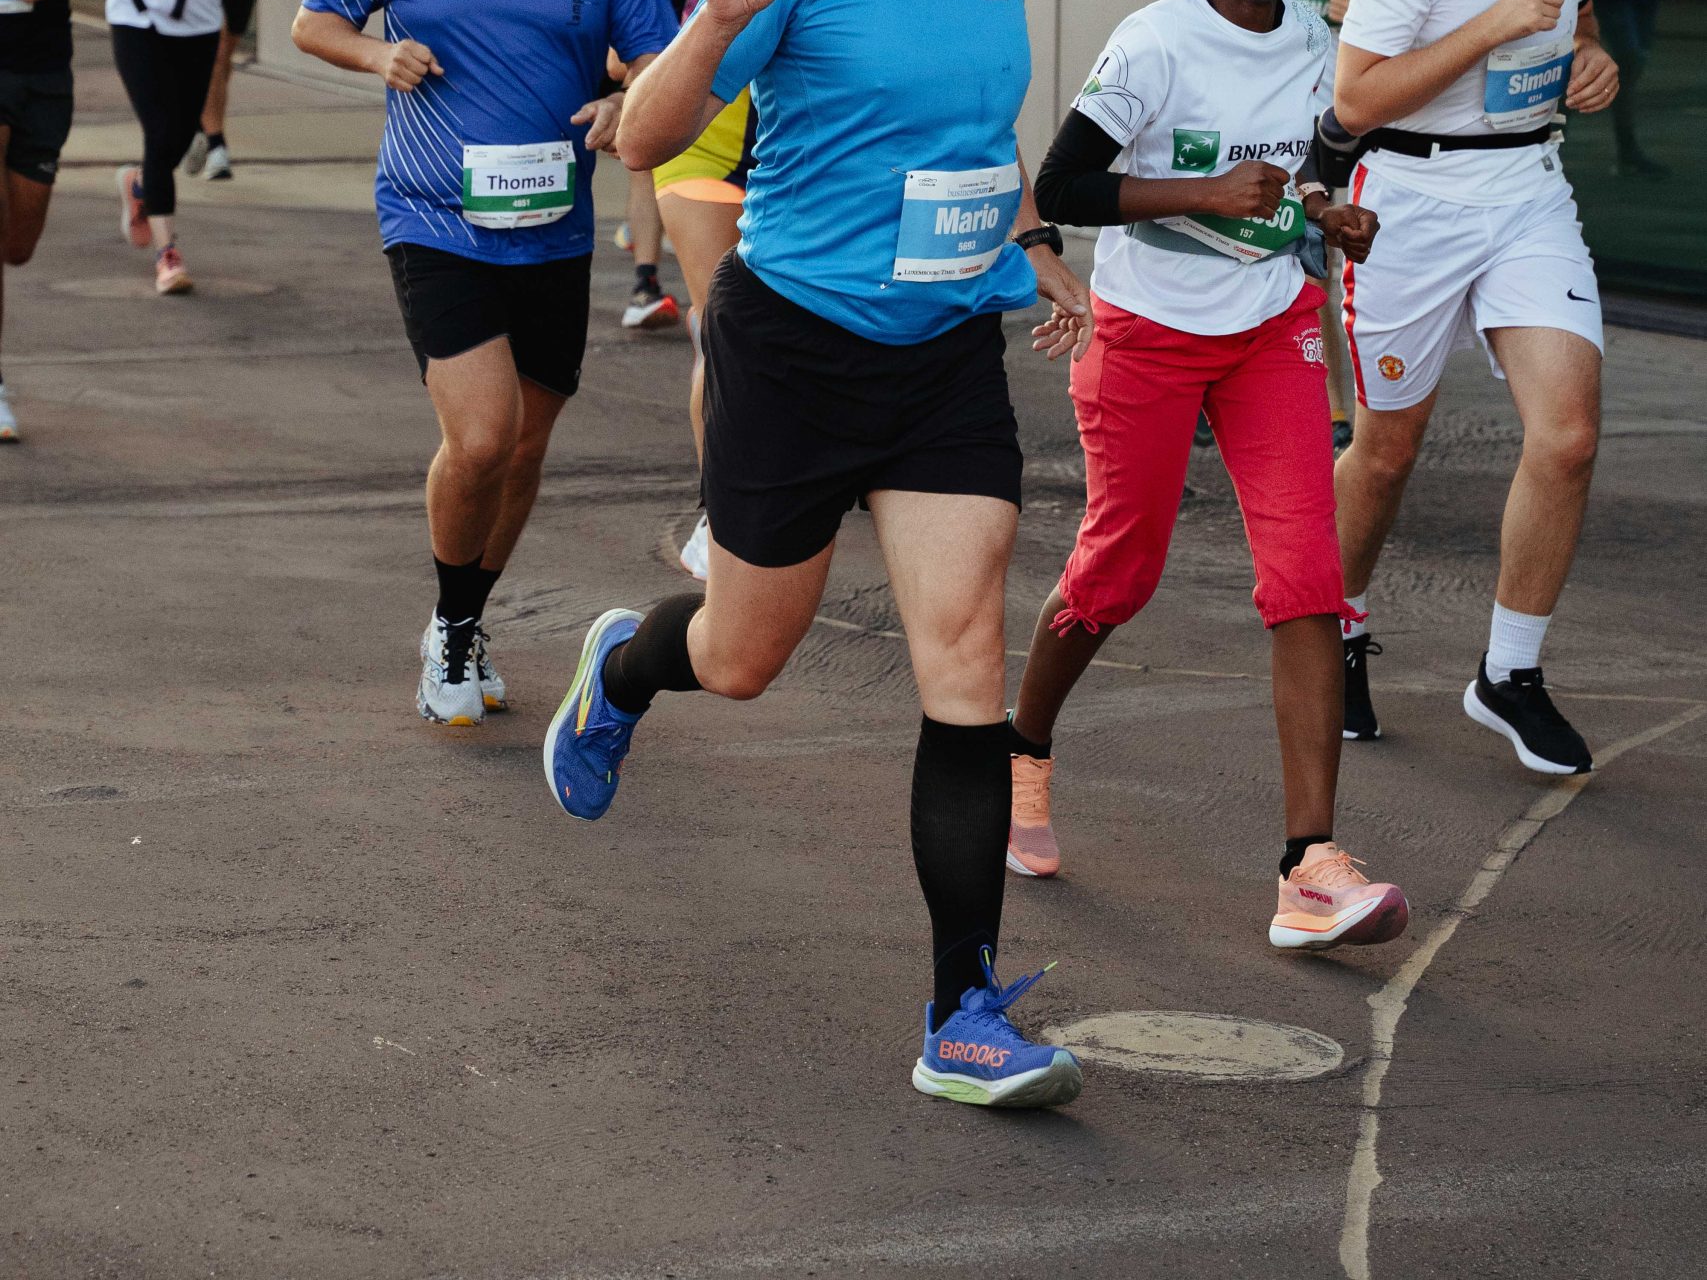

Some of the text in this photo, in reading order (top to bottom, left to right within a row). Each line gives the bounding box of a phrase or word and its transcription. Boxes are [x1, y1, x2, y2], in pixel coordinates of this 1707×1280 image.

[1508, 66, 1562, 95] Simon
[1227, 144, 1271, 162] BNP
[486, 174, 555, 190] Thomas
[935, 204, 998, 234] Mario
[1239, 227, 1254, 239] 157
[957, 240, 976, 252] 5693
[939, 1040, 1012, 1068] BROOKS
